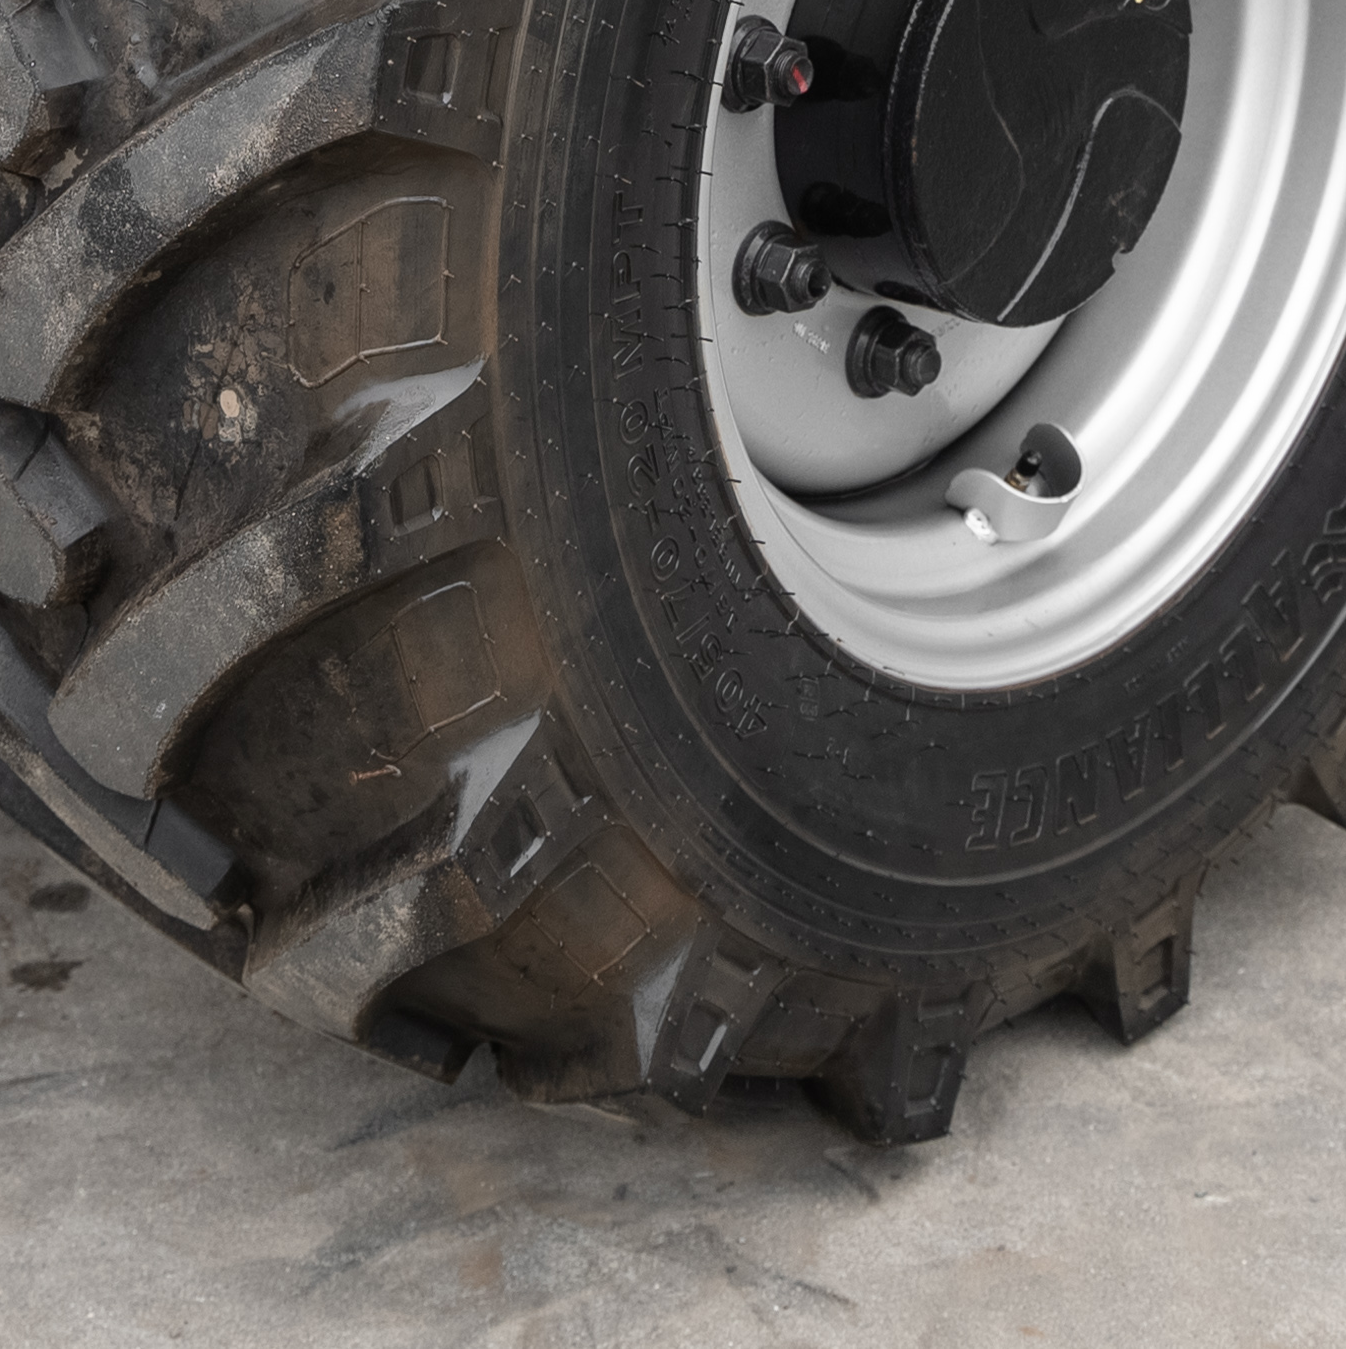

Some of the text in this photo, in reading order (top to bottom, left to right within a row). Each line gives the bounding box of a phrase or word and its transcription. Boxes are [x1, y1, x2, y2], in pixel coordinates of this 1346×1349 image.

[611, 189, 770, 745] 405/70-20 MPT
[964, 548, 1308, 853] ALLIANCE
